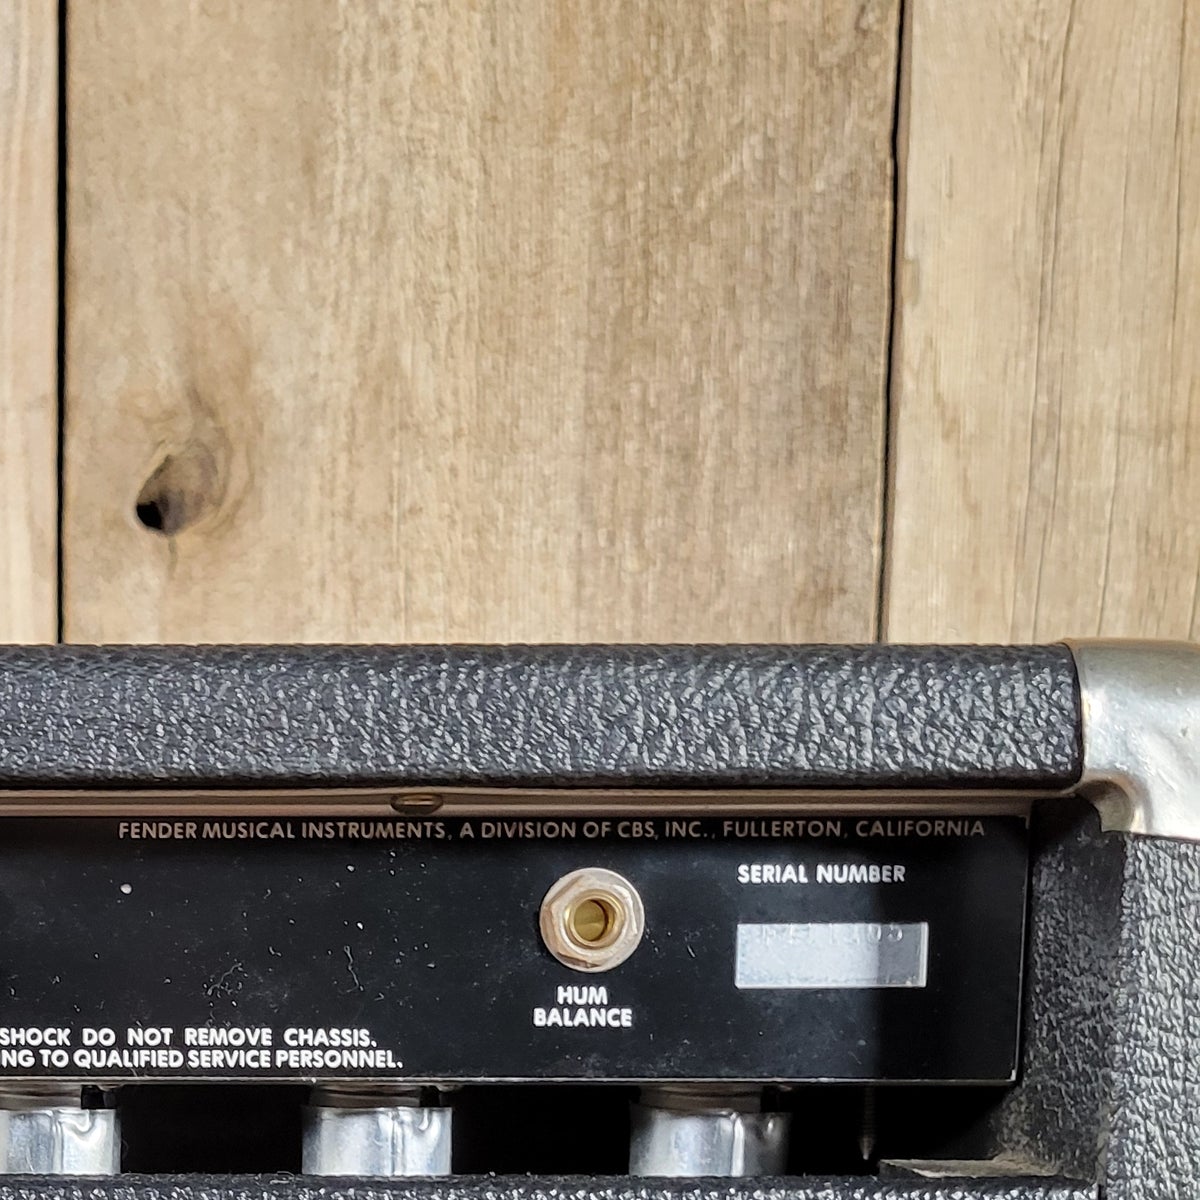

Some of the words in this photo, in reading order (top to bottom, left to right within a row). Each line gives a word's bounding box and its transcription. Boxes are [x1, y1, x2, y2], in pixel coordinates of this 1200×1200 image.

[118, 822, 197, 839] FENDER
[202, 821, 295, 839] MUSICAL
[300, 820, 453, 841] INSTRUMENTS,
[459, 822, 475, 838] A
[481, 821, 576, 839] DIVISION
[582, 821, 611, 838] OF
[617, 821, 658, 839] CBS,
[855, 820, 985, 837] CALIFORNIA
[737, 864, 809, 884] SERIAL
[816, 864, 905, 884] NUMBER
[557, 985, 608, 1006] HUM
[533, 1007, 633, 1028] BALANCE
[82, 1027, 116, 1047] DO
[127, 1027, 174, 1047] NOT
[184, 1027, 273, 1047] REMOVE
[283, 1027, 377, 1048] CHASSIS.
[38, 1049, 69, 1068] TO
[73, 1048, 184, 1069] QUALIFIED
[187, 1049, 271, 1069] SERVICE
[275, 1049, 403, 1069] PERSONNEL.
